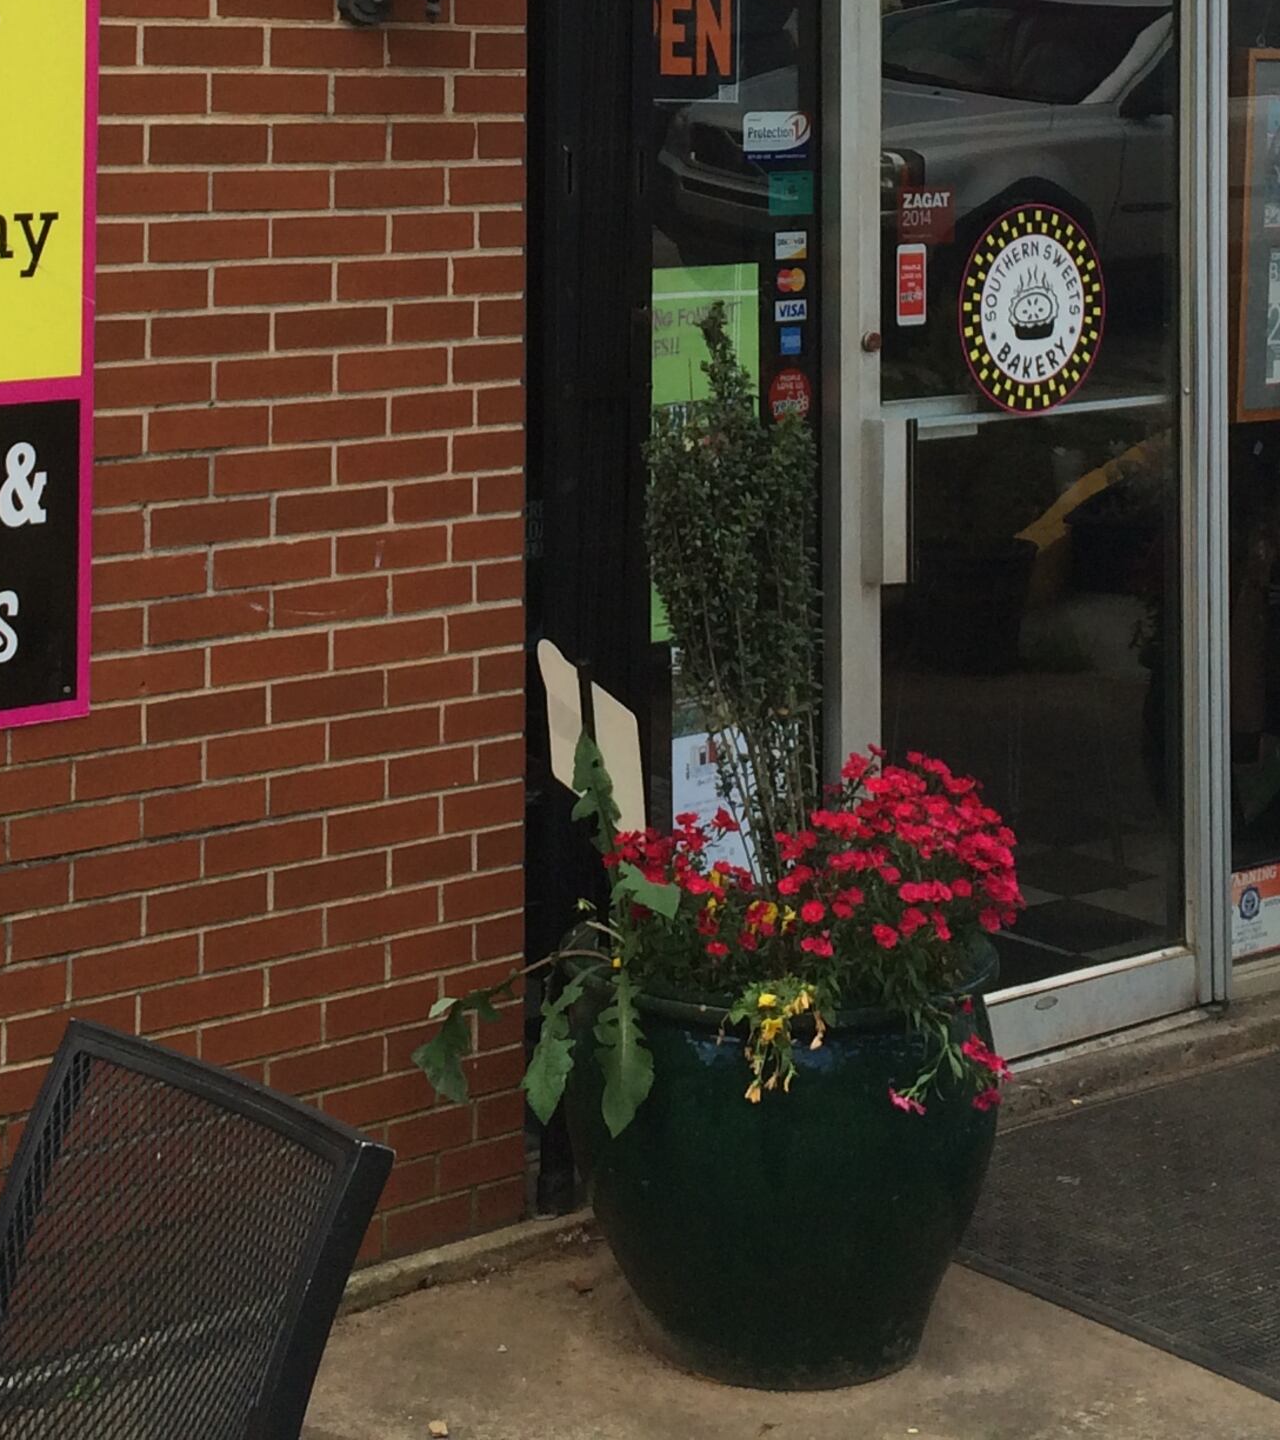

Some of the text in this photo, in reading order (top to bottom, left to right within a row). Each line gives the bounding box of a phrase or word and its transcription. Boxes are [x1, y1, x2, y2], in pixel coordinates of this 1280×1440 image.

[902, 192, 950, 209] ZAGAT
[902, 210, 932, 227] 2014
[985, 241, 1081, 322] SOUTHERN SWEETS
[778, 304, 806, 318] VISA
[997, 336, 1068, 378] BAKERY
[1232, 865, 1277, 888] ARNING
